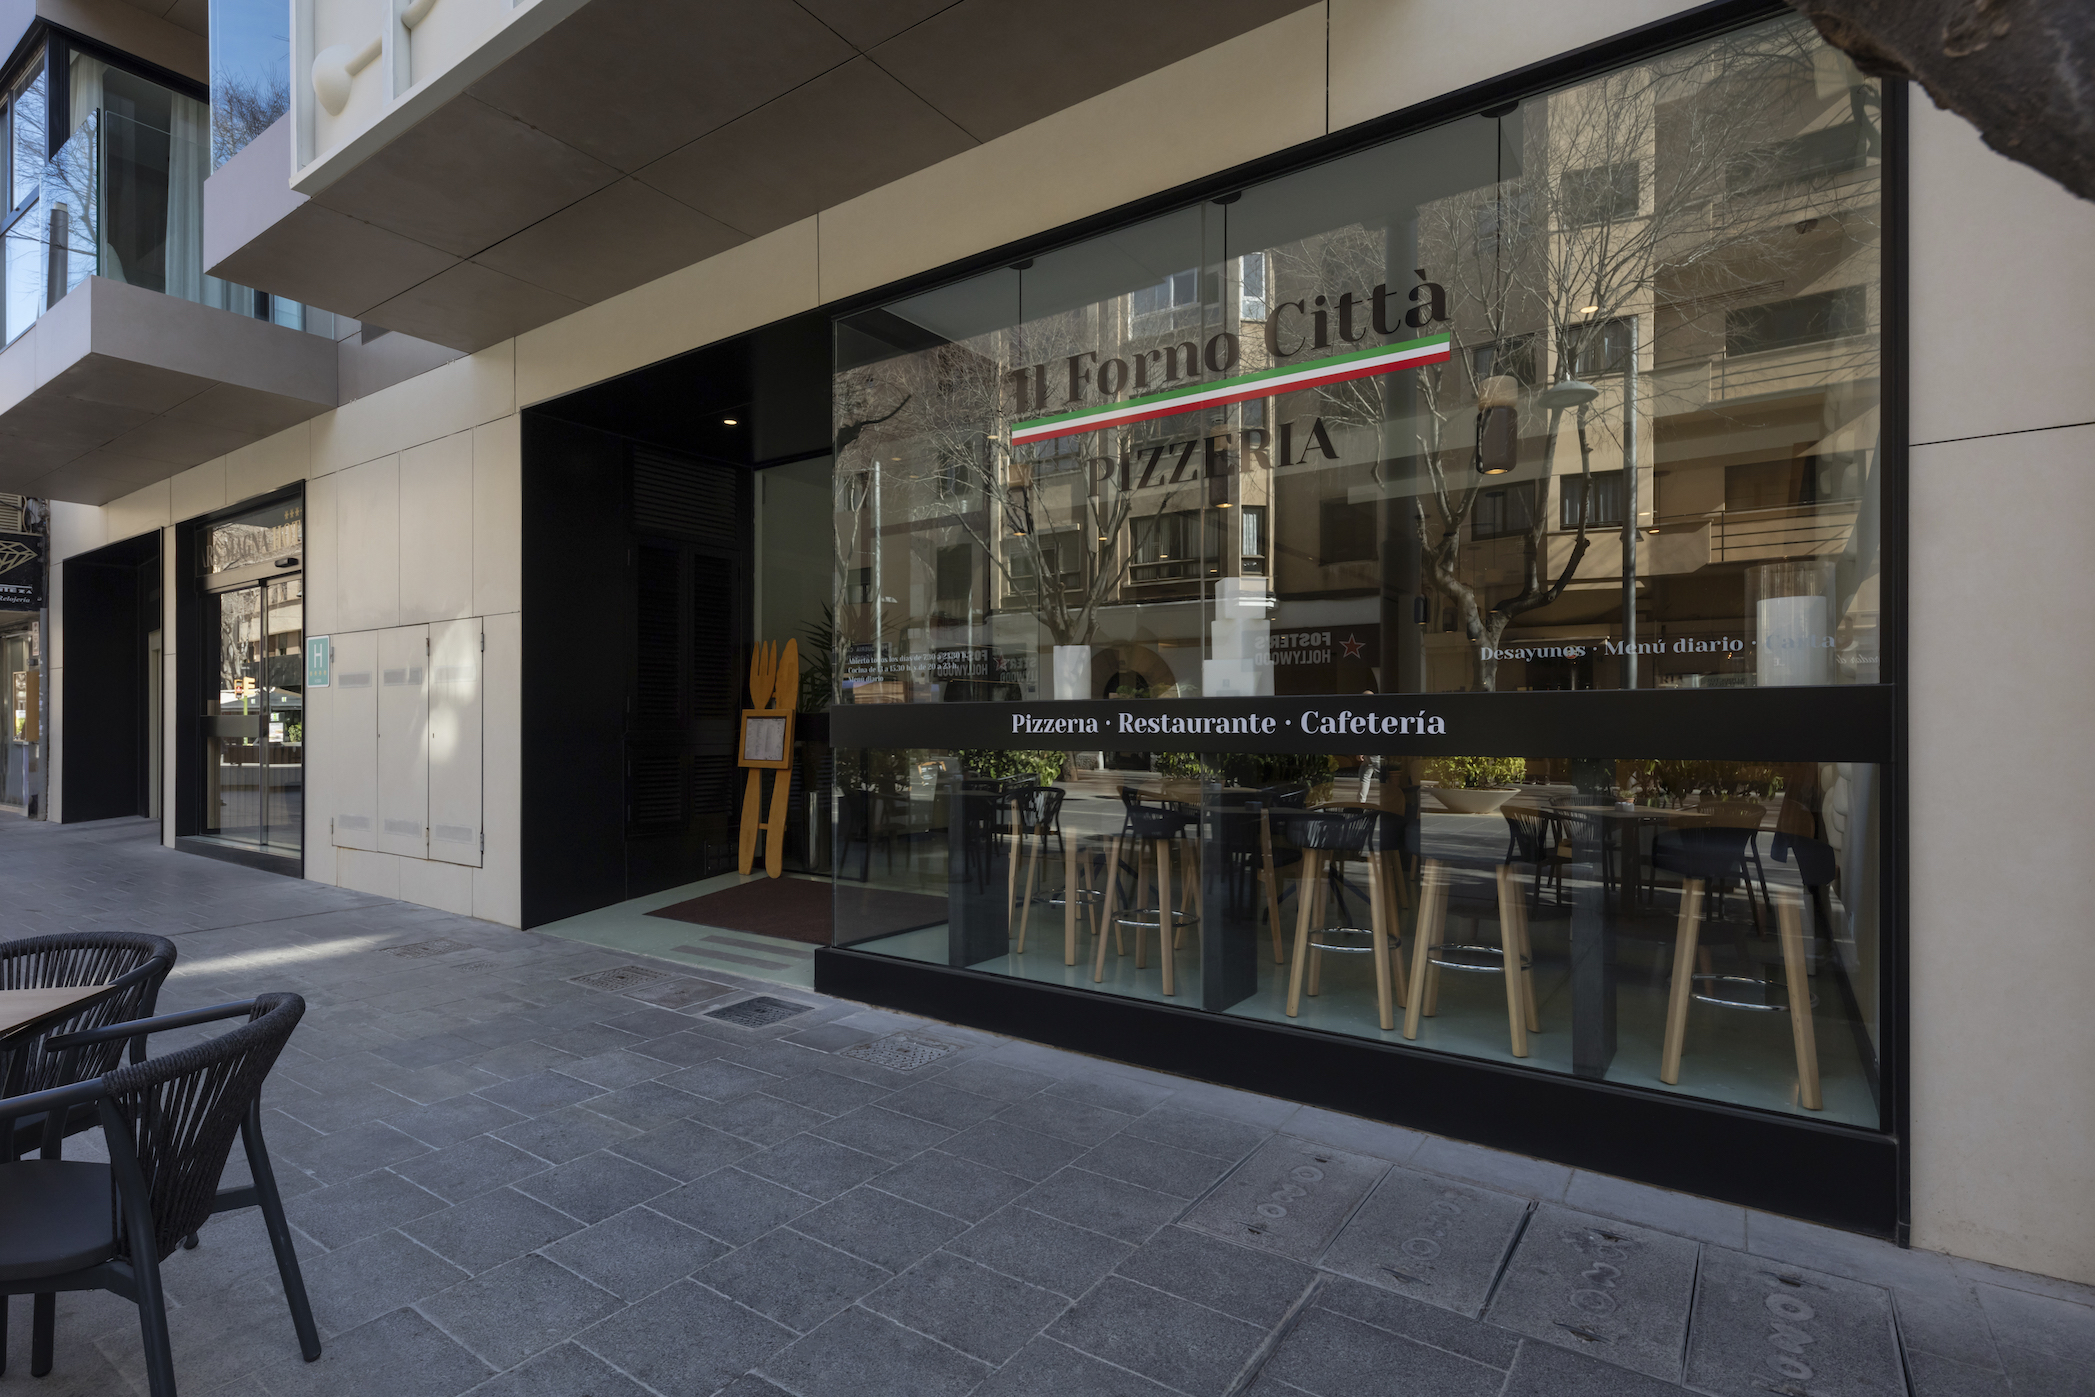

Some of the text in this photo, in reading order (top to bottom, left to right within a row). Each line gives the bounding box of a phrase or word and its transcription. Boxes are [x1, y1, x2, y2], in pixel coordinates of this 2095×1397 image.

[1010, 268, 1451, 414] Il Forno Città
[1087, 416, 1340, 498] PIZZERIA
[313, 643, 323, 668] H
[1481, 644, 1586, 663] Desayunos
[1604, 638, 1666, 656] Menú
[1673, 636, 1744, 654] diario
[848, 666, 868, 674] Cocina
[1011, 710, 1446, 735] Pizzeria Restaurante Cafetería
